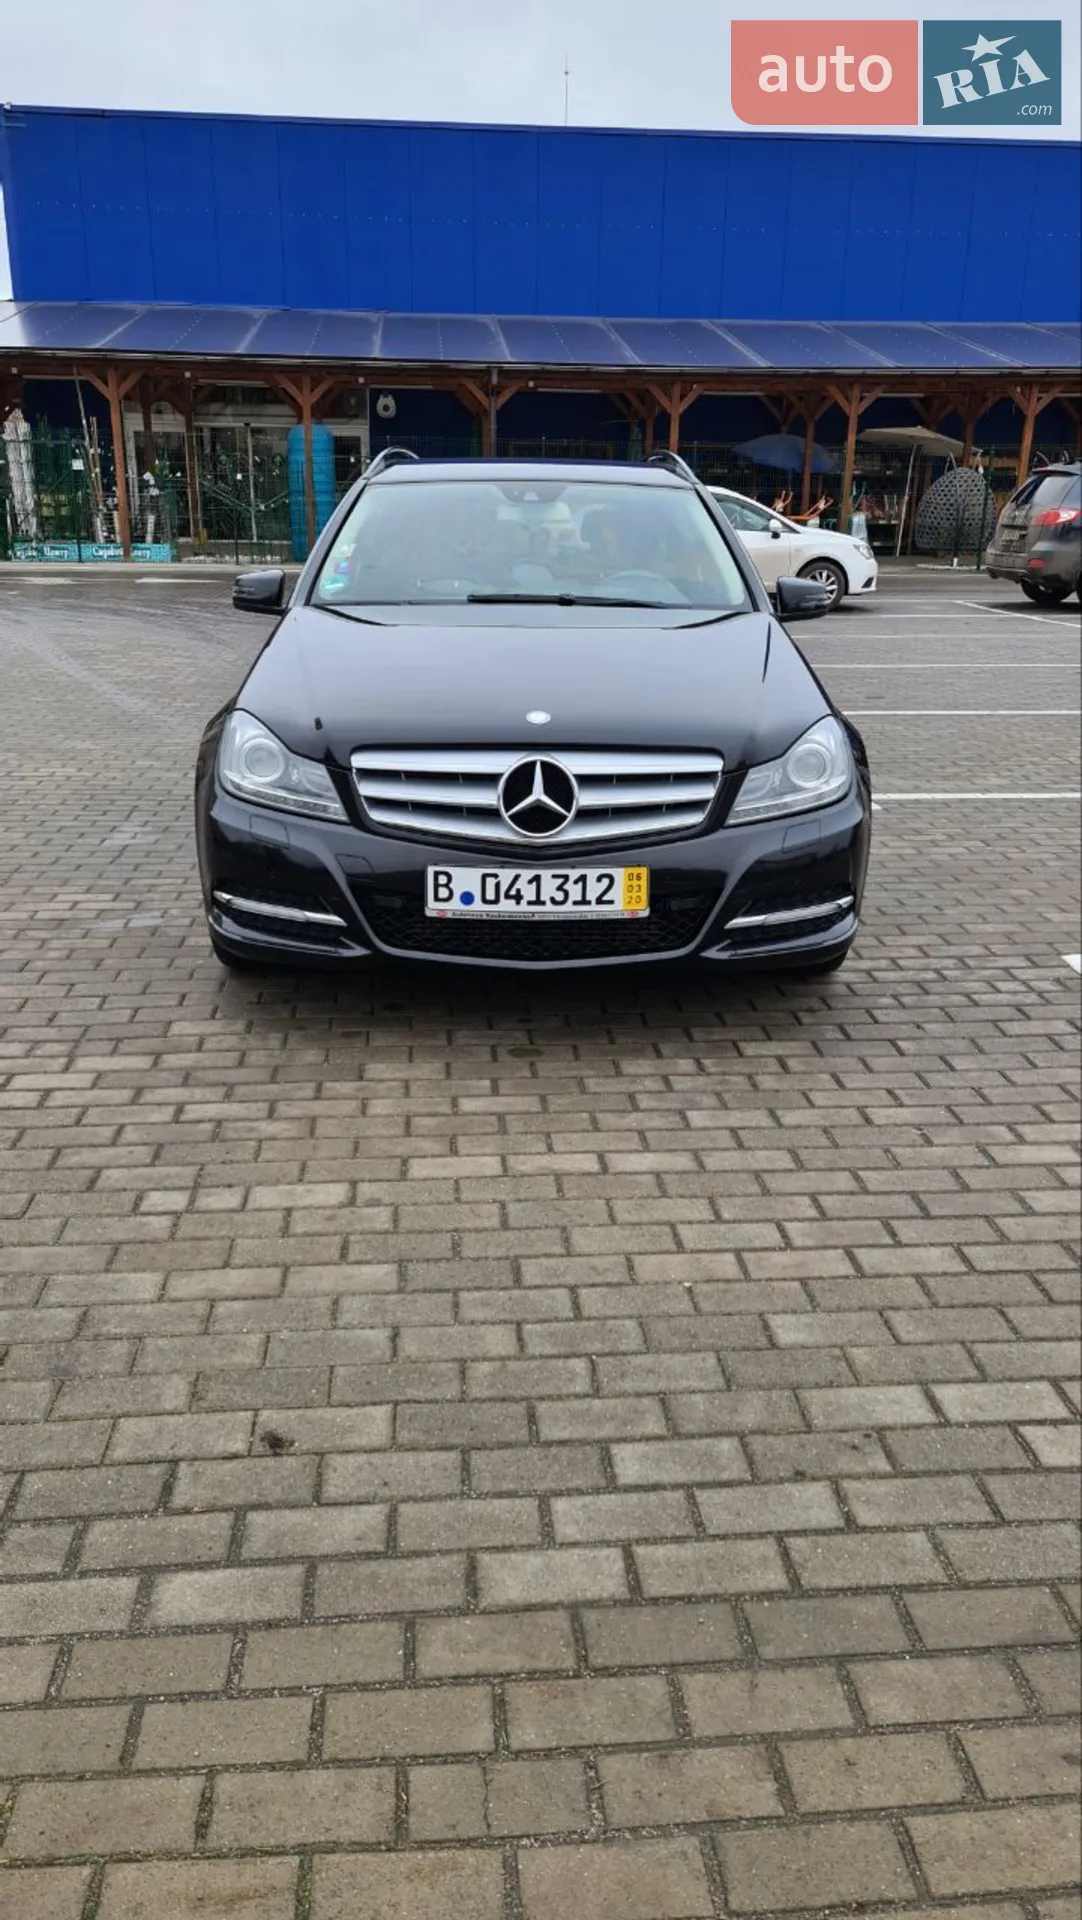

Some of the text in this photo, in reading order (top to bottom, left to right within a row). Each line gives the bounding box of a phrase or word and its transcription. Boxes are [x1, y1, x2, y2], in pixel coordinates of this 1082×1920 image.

[628, 872, 642, 881] 06
[433, 870, 616, 906] B 041312
[627, 884, 642, 893] 03
[627, 895, 642, 904] 20
